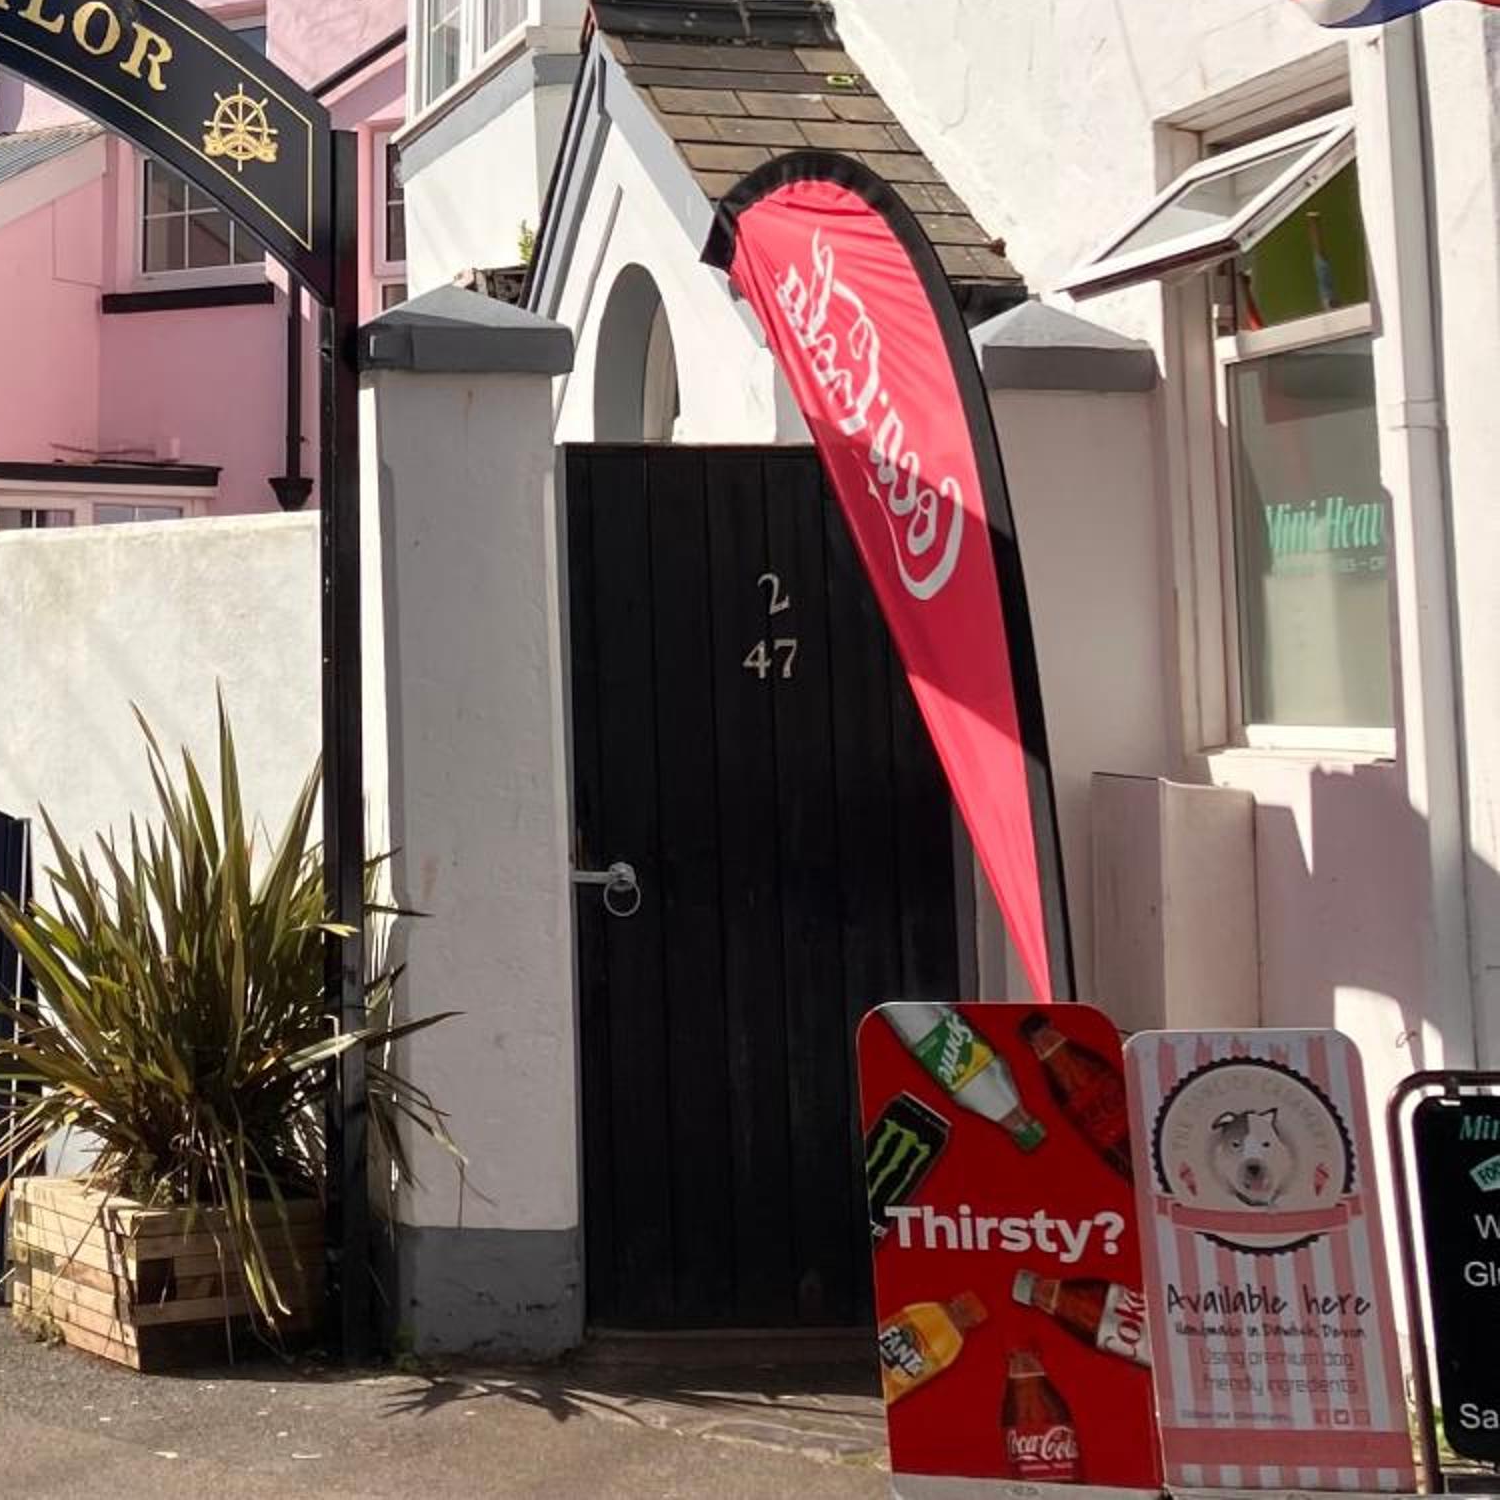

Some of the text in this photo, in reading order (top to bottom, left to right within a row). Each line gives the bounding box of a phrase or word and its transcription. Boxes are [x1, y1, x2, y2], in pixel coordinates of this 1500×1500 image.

[758, 573, 790, 615] 2
[743, 638, 799, 679] 47
[884, 1204, 1125, 1263] Thirsty?
[1167, 1283, 1371, 1316] Available here
